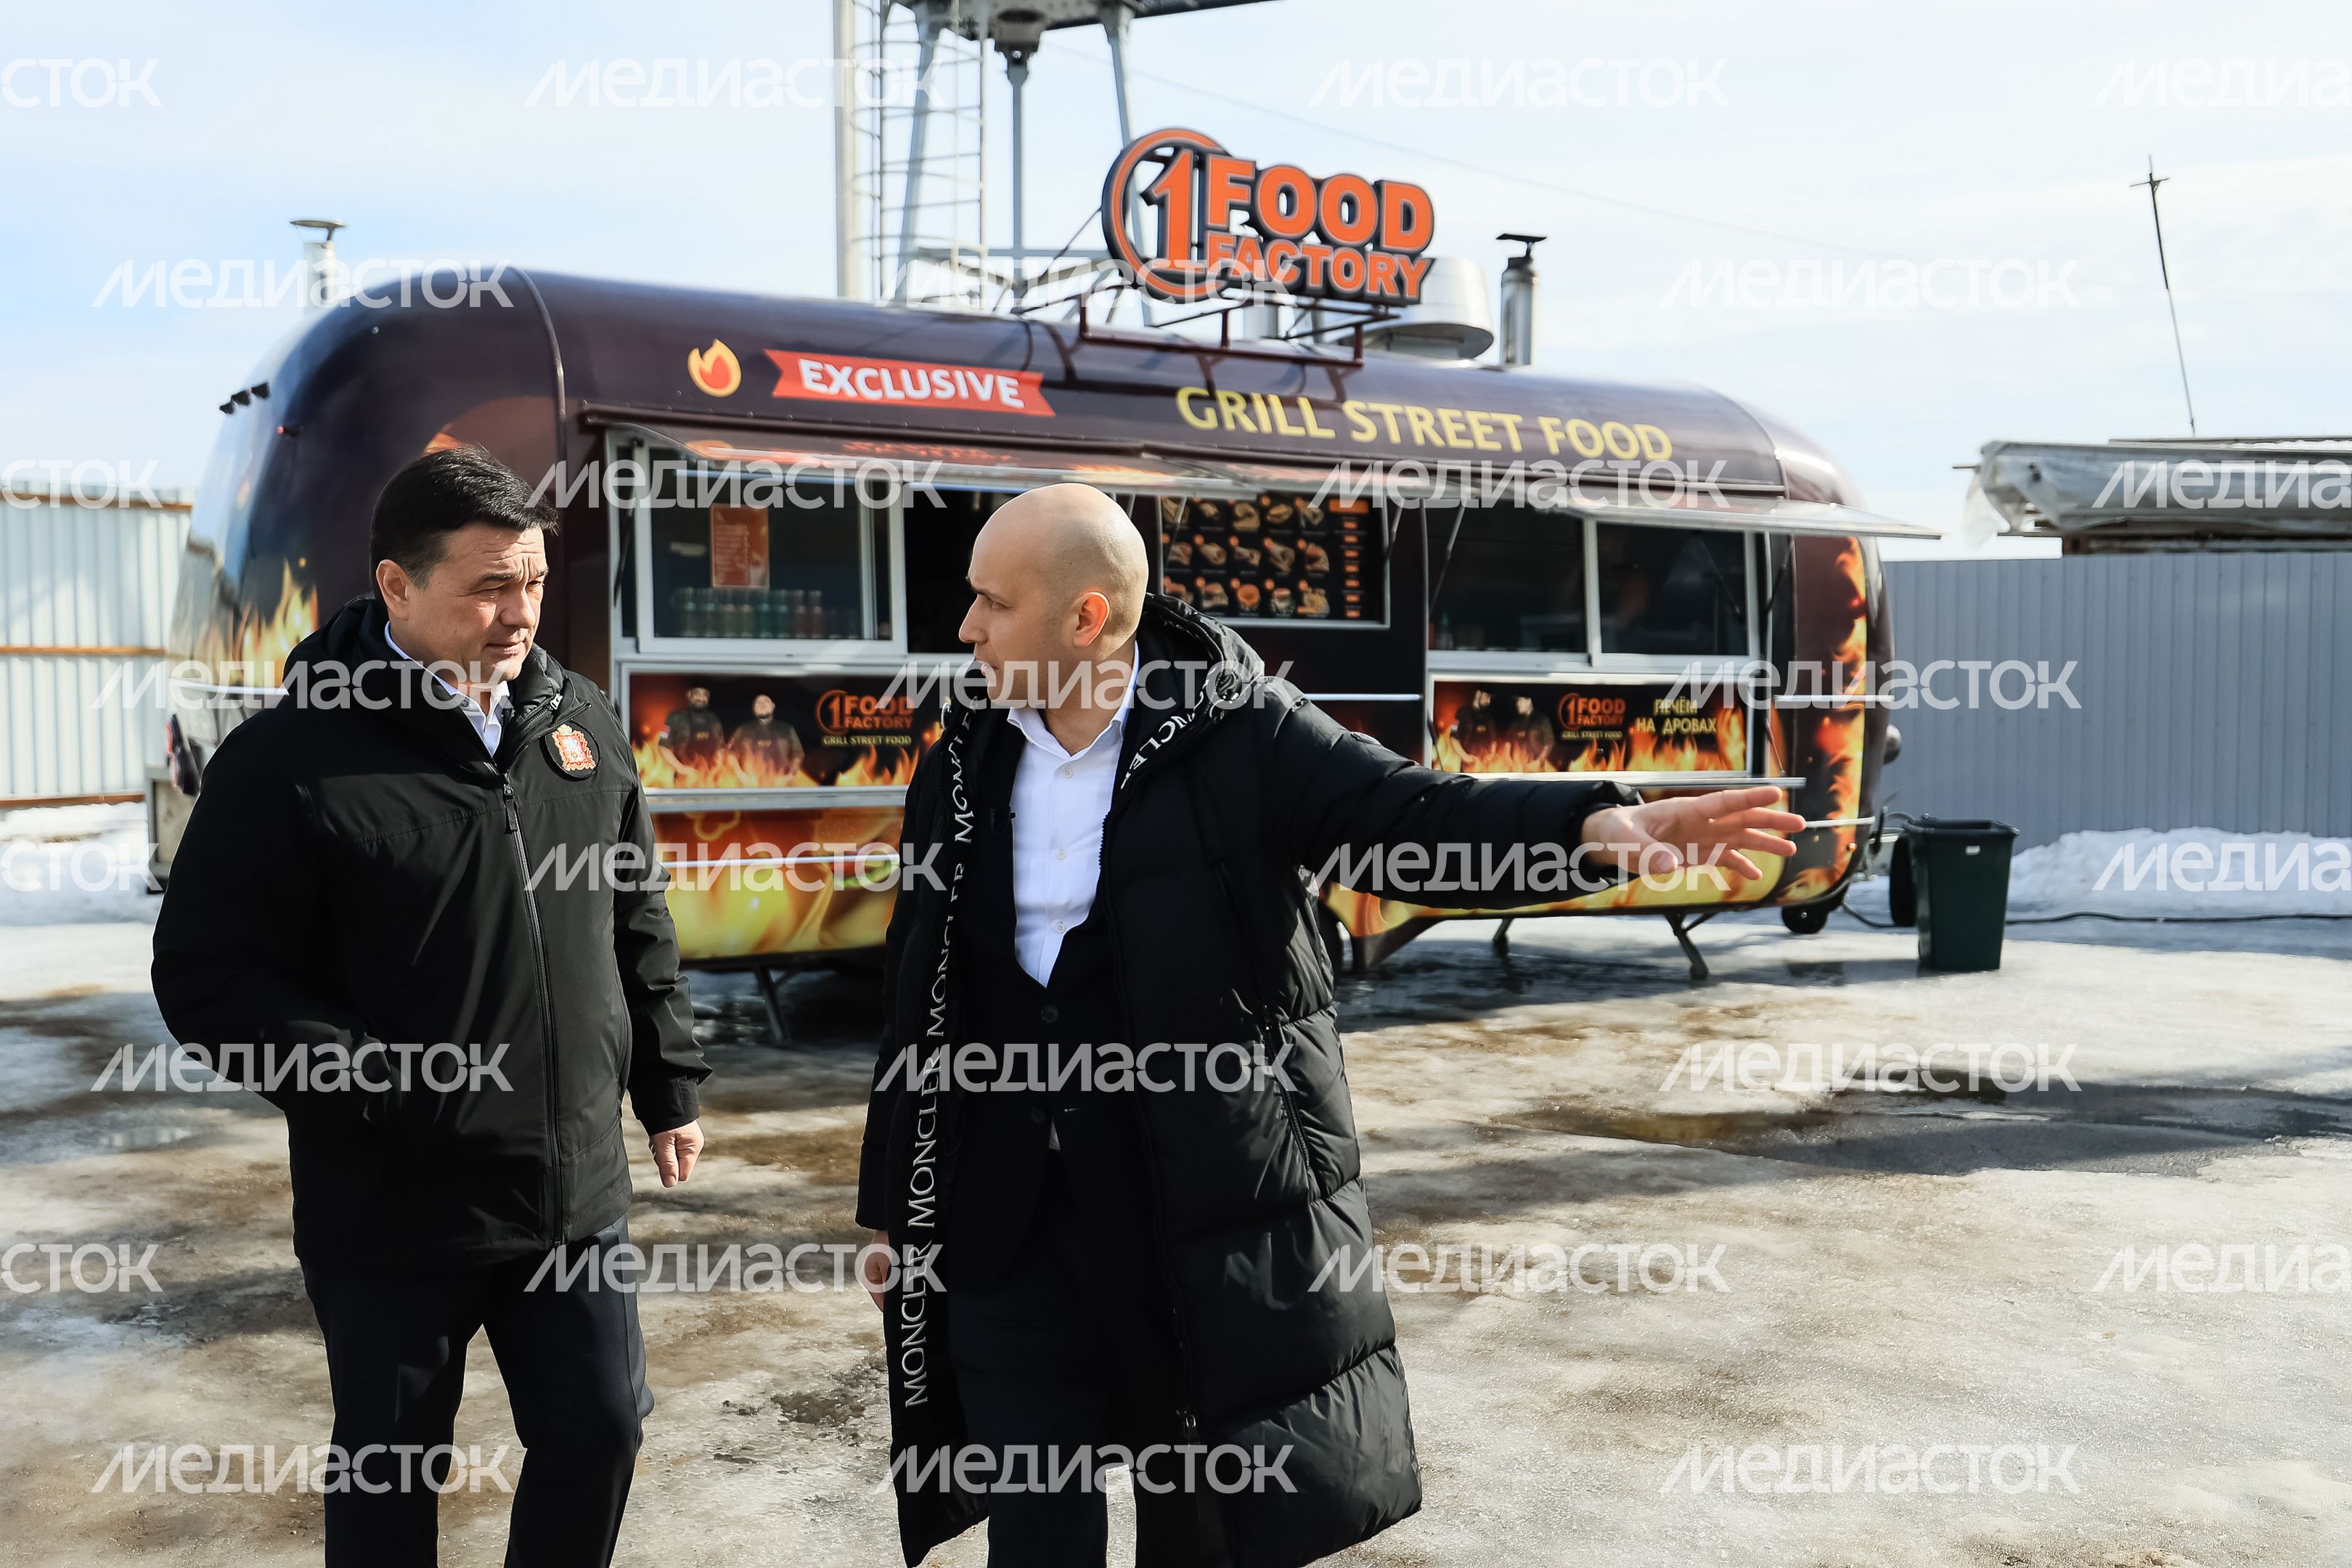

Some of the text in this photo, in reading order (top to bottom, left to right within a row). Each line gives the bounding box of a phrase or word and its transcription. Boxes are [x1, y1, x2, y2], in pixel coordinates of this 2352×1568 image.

[1204, 154, 1434, 254] FOOD
[1204, 229, 1434, 299] FACTORY
[797, 357, 1026, 409] EXCLUSIVE
[1175, 386, 1674, 462] GRILL STREET FOOD
[844, 695, 916, 716] FOOD
[844, 716, 914, 730] FACTORY
[1577, 698, 1626, 714] FOOD
[1577, 714, 1625, 726] FACTORY
[822, 735, 912, 746] GRILL STREET FOOD
[1636, 717, 1718, 735] НА ДРОВАХ
[907, 1046, 942, 1228] MONCLER
[902, 1239, 933, 1408] MONCLER
